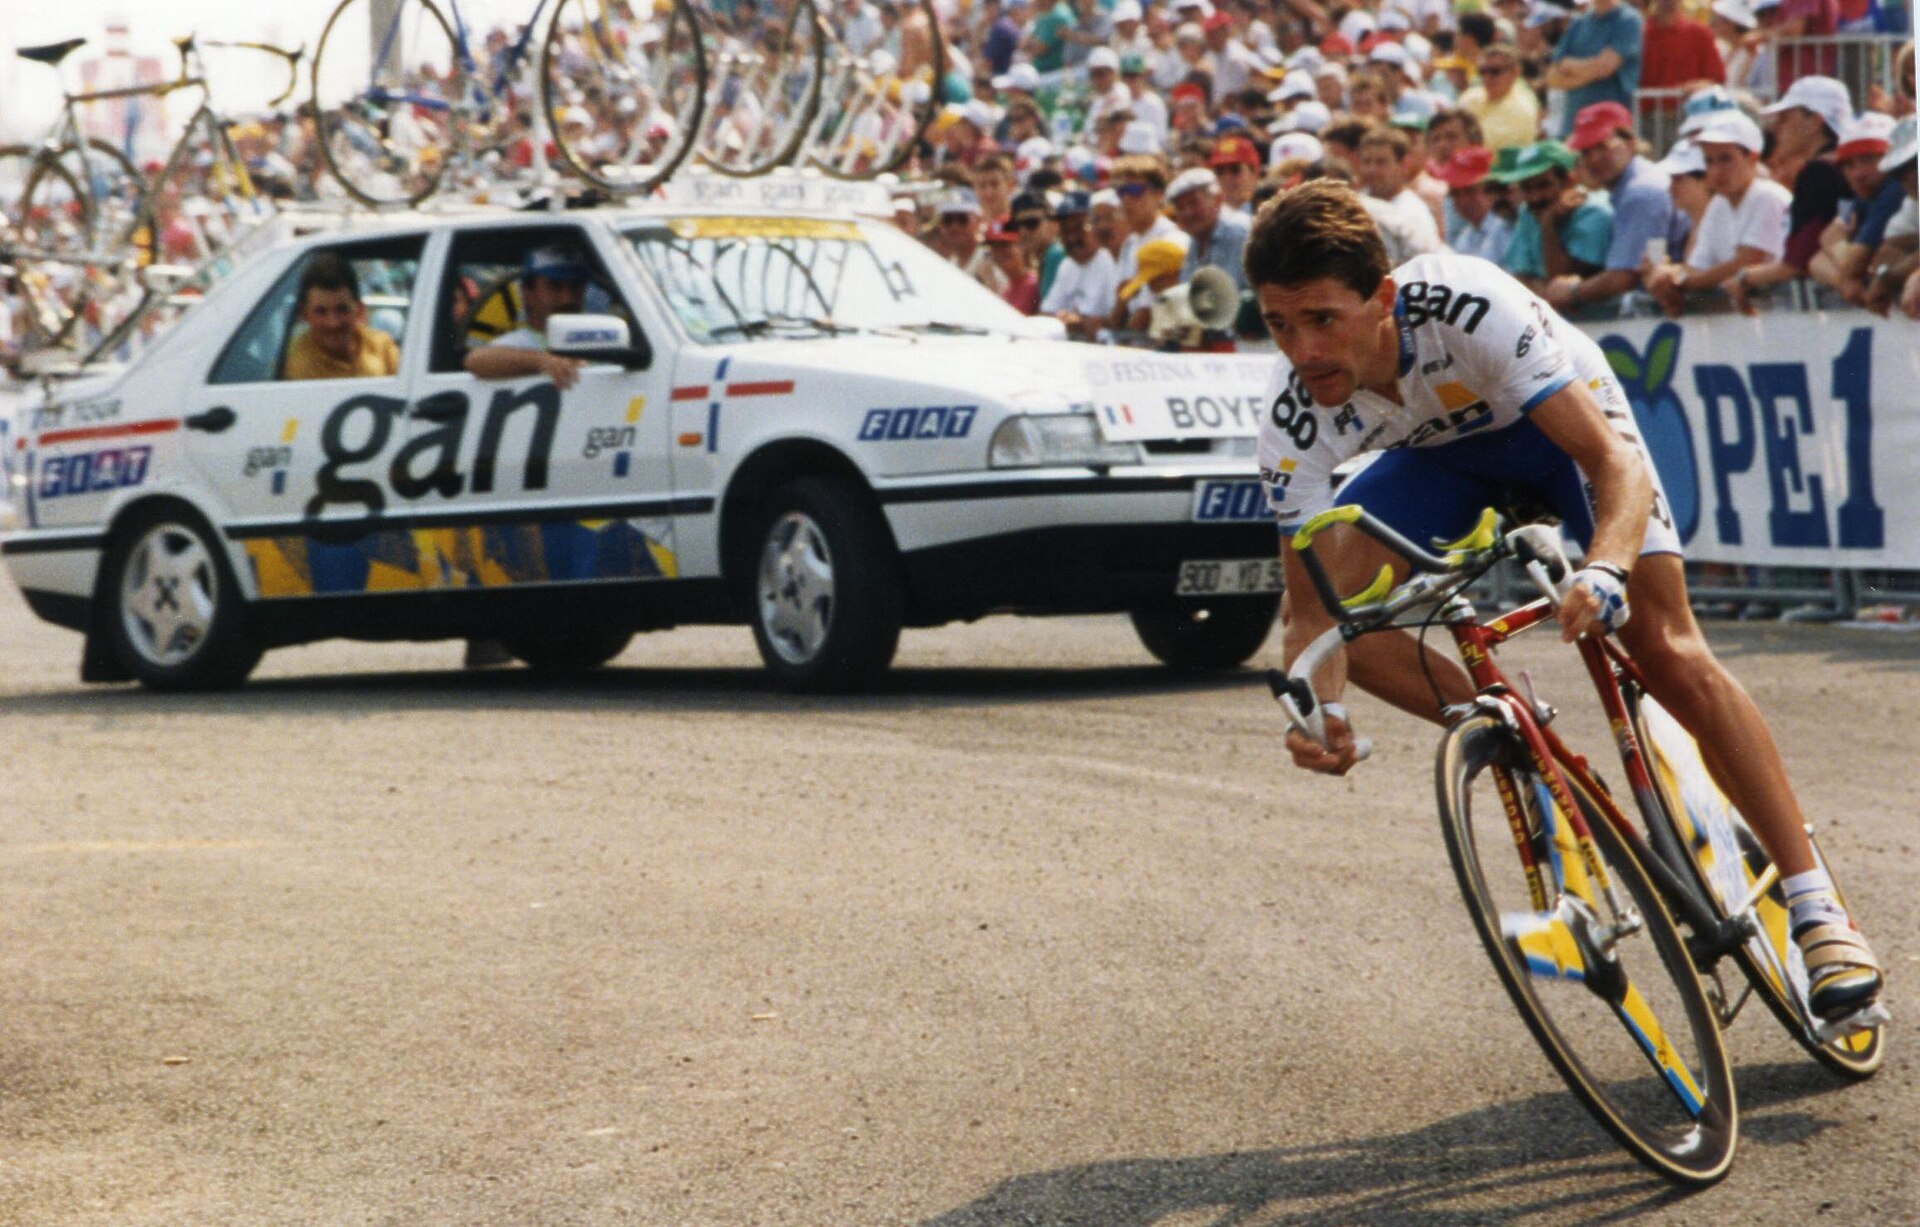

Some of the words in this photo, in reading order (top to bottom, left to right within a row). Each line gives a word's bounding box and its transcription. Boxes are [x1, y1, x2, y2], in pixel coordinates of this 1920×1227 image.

[1400, 281, 1490, 335] gan
[1111, 360, 1198, 382] FESTINA
[862, 408, 974, 438] FIAT
[584, 424, 637, 460] gan
[43, 448, 149, 496] FIAT
[243, 445, 292, 477] gan
[305, 382, 563, 546] gan
